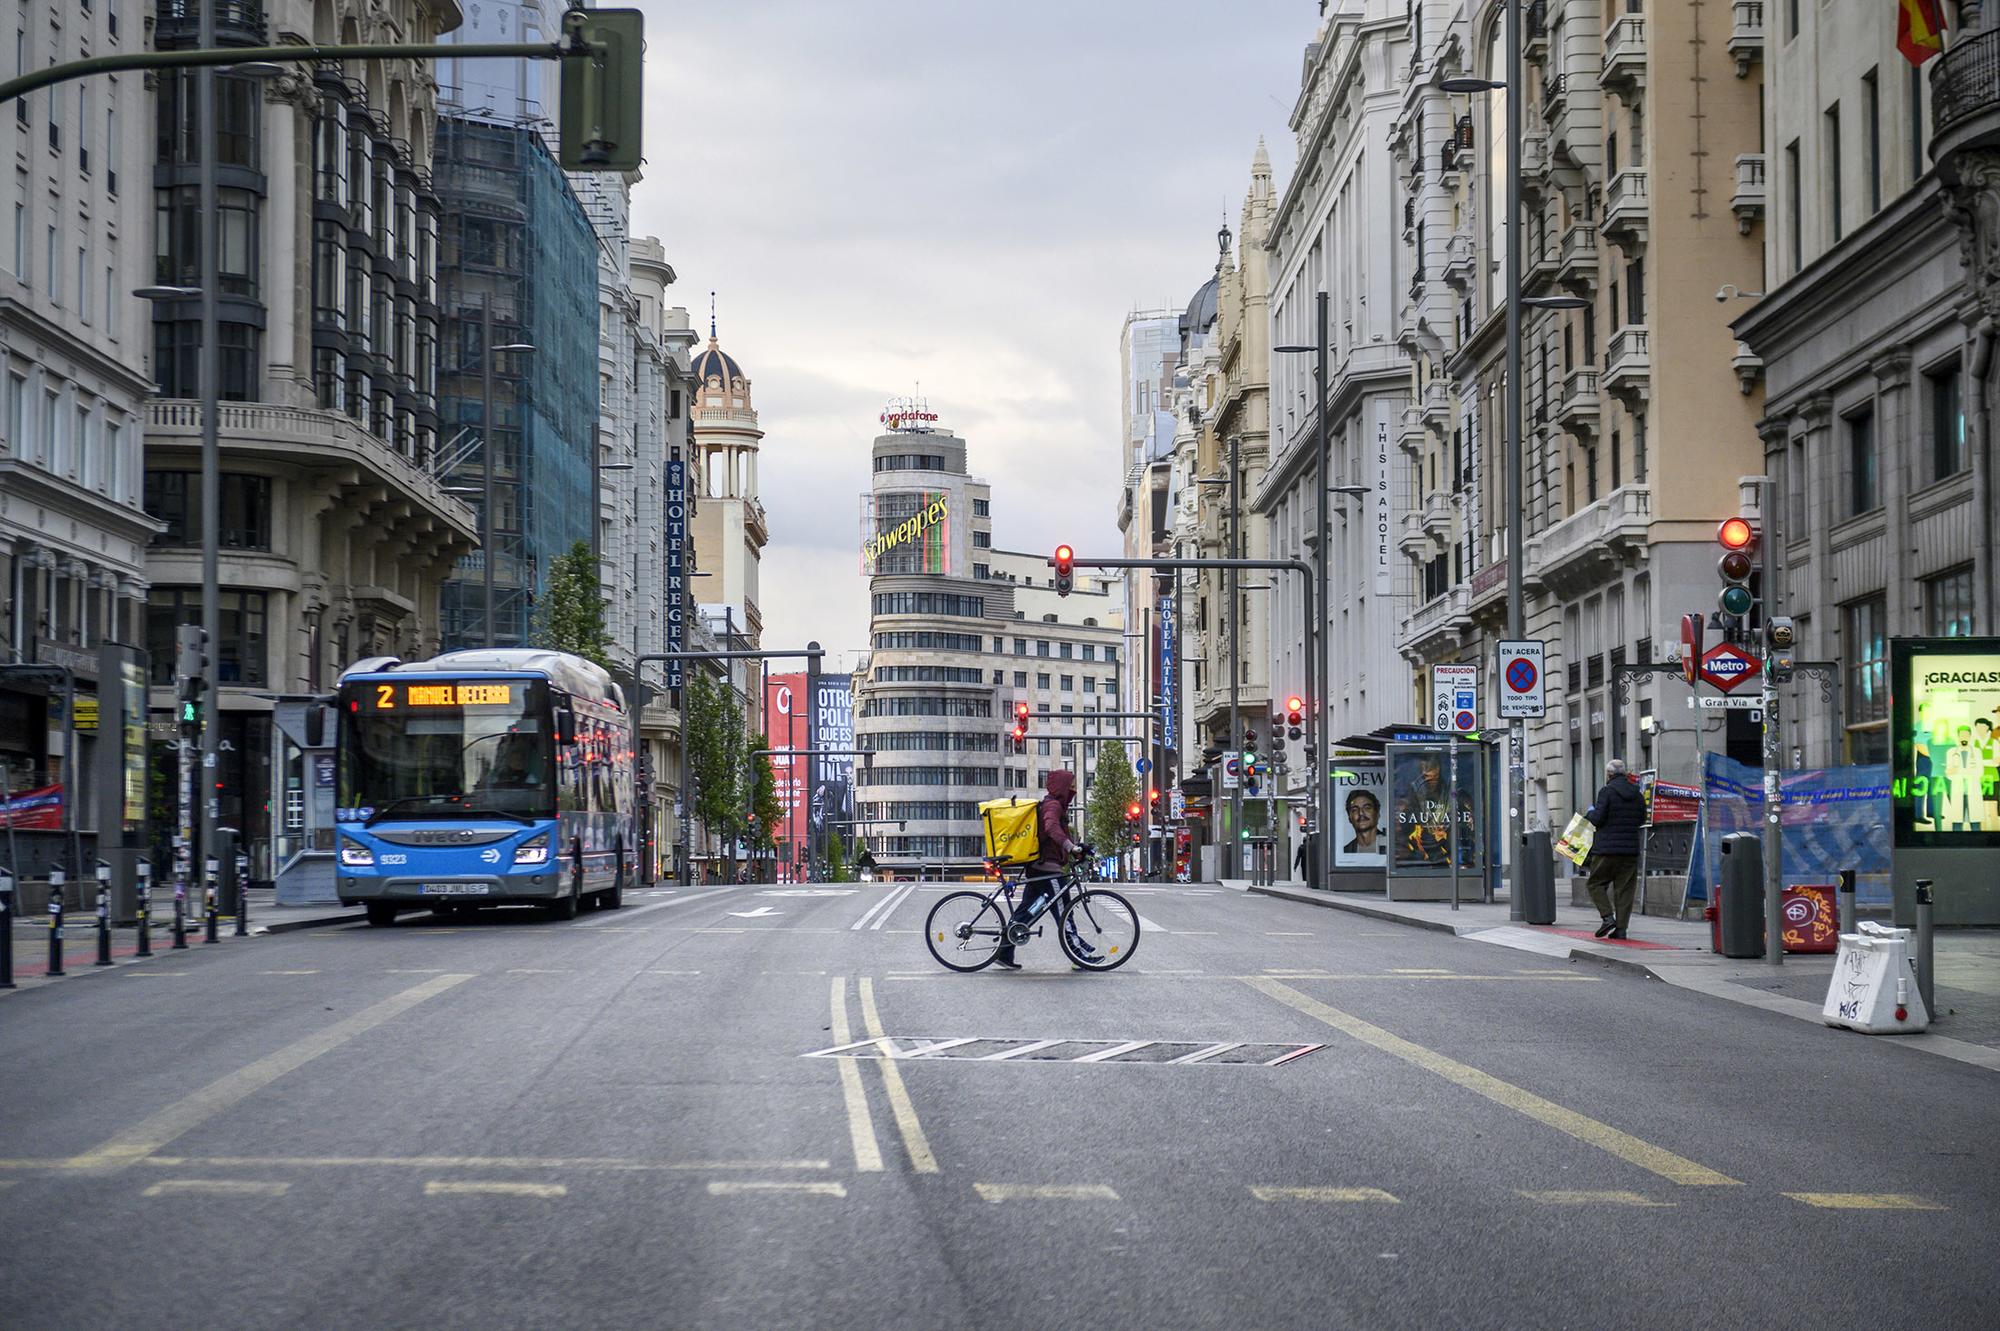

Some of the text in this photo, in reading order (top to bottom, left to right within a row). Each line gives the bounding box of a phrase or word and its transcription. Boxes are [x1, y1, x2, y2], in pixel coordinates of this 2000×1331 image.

[888, 410, 938, 421] vodafone
[1378, 422, 1387, 464] THIS
[1379, 470, 1387, 491] IS
[1379, 497, 1387, 506] A
[863, 495, 948, 568] Schweppes
[1378, 512, 1388, 565] HOTEL
[668, 489, 684, 687] HOTEL REGENTE
[1162, 600, 1172, 650] HOTEL
[1710, 660, 1744, 671] Metro
[377, 685, 394, 708] 2
[1705, 699, 1729, 707] Gran
[819, 728, 852, 741] QUE ES
[1659, 788, 1691, 797] CIERRE
[1427, 800, 1444, 809] Dior
[415, 830, 474, 843] IVECO
[1000, 827, 1030, 842] Glovo
